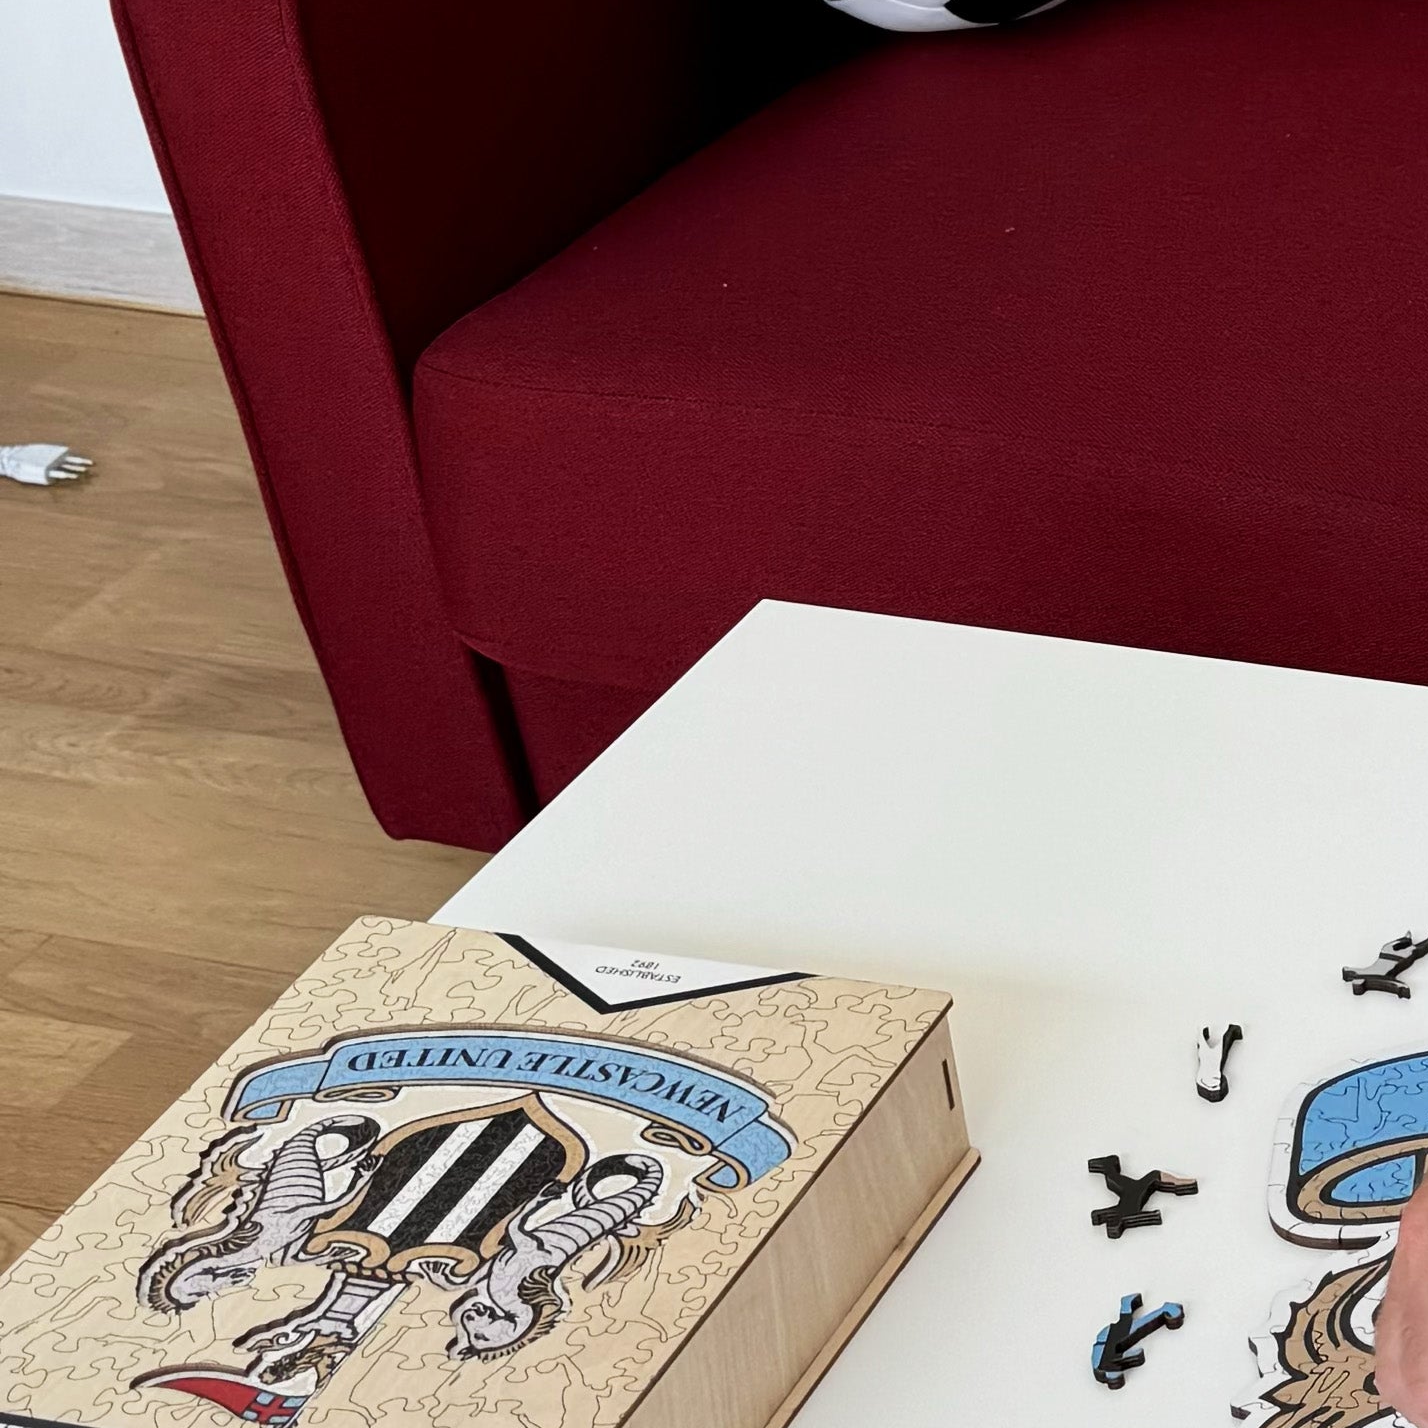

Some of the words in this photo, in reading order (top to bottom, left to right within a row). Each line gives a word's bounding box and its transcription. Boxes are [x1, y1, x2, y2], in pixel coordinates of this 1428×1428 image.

[595, 966, 681, 984] ESTABLISHED
[631, 960, 660, 970] 1892
[347, 1047, 513, 1072] UNITED
[514, 1051, 747, 1124] NEWCASTLE
